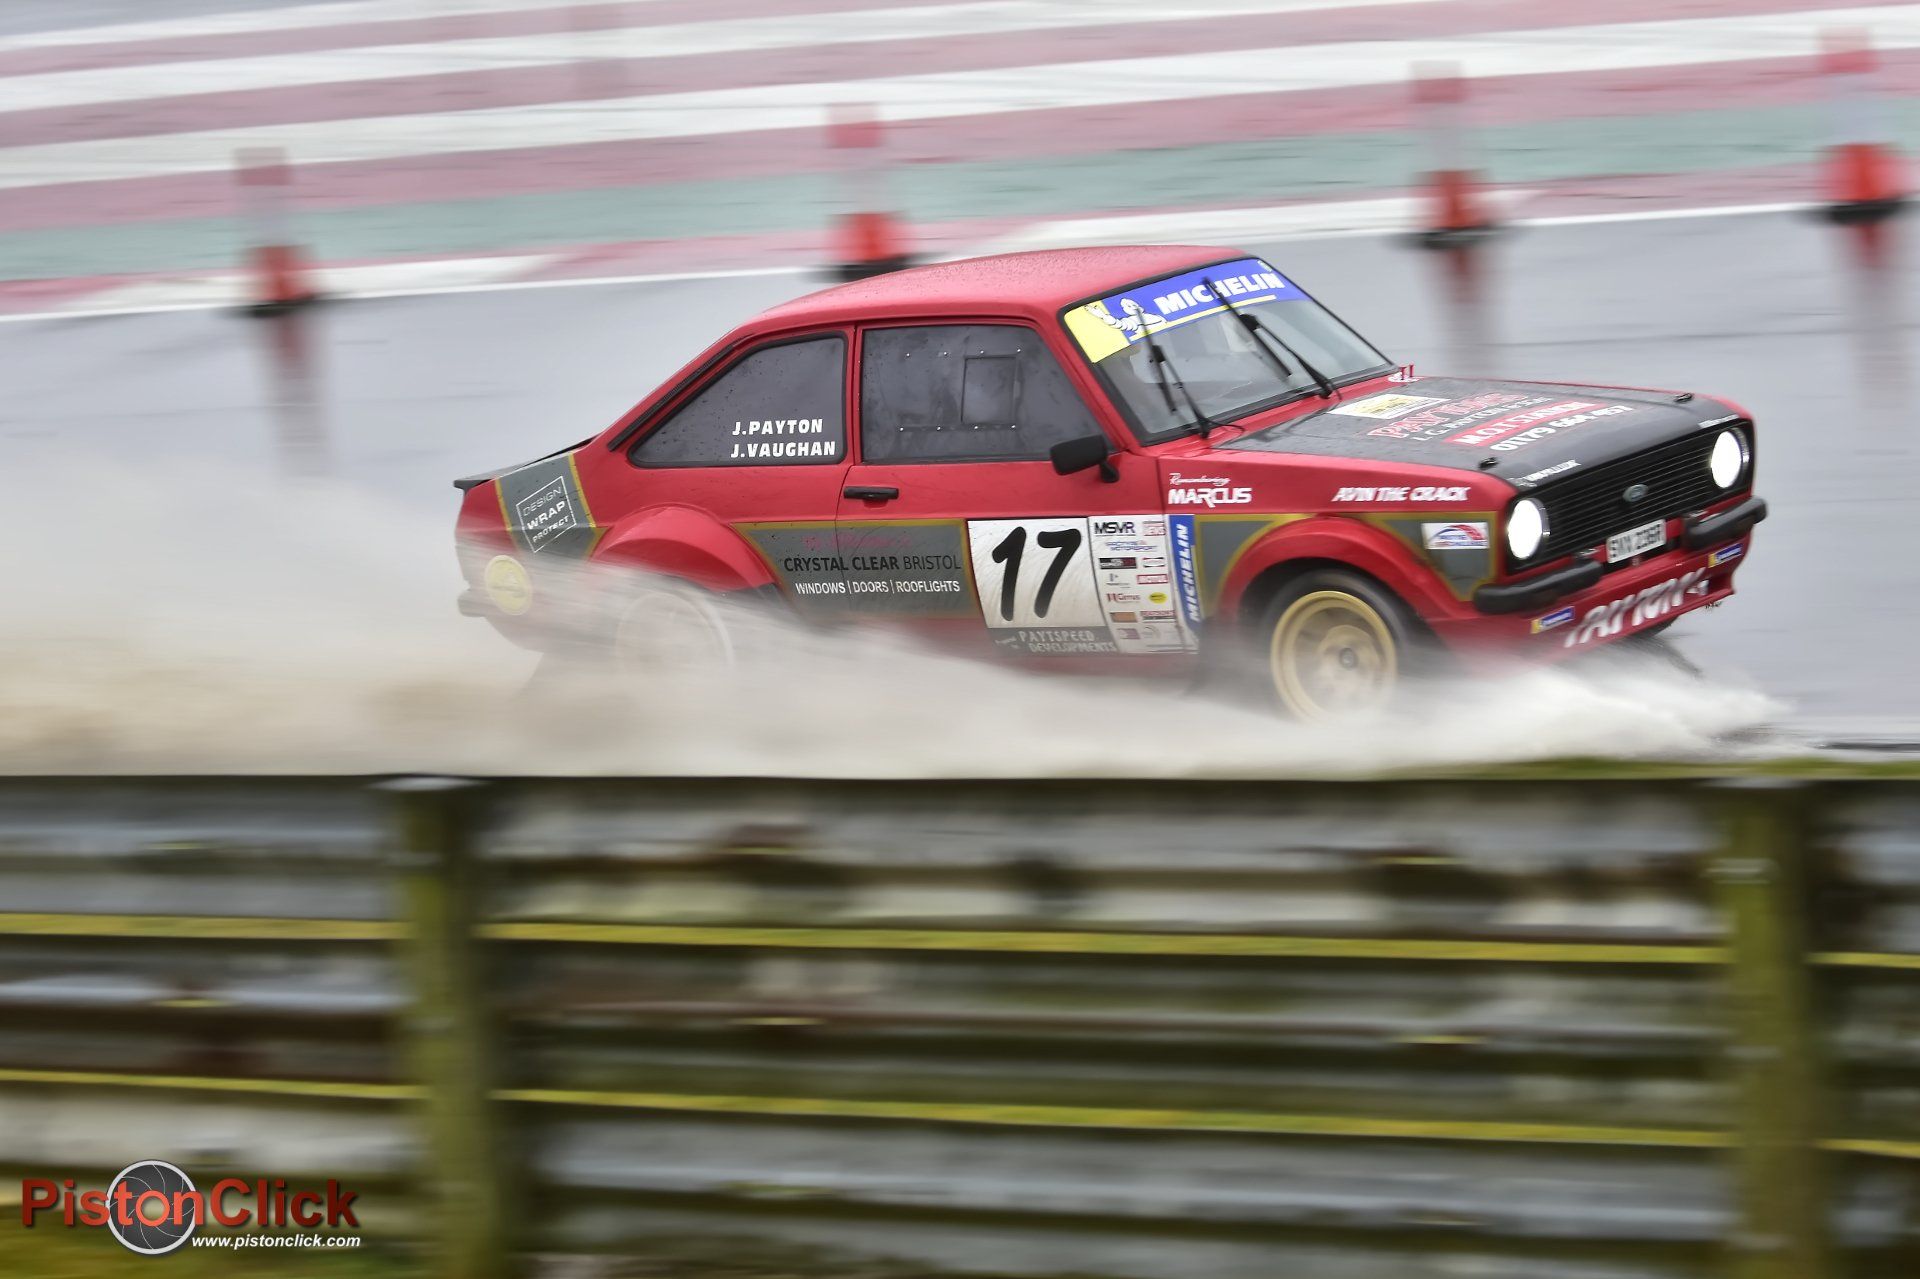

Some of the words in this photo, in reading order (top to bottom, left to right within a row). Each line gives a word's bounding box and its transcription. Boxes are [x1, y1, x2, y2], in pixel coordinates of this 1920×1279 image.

[1153, 273, 1285, 315] MICHELIN
[732, 418, 823, 436] J.PAYTON
[731, 441, 836, 458] J.VAUGHAN
[523, 487, 561, 516] DESIGN
[1168, 487, 1253, 508] MARCUS
[1375, 486, 1410, 502] THE
[527, 501, 565, 530] WRAP
[532, 515, 569, 543] PROTECT
[1094, 522, 1136, 535] MSVR
[784, 557, 849, 572] CRYSTAL
[852, 556, 899, 571] CLEAR
[903, 555, 961, 570] BRISTOL
[1176, 523, 1200, 623] MICHELIN
[991, 526, 1081, 621] 17
[795, 582, 846, 595] WINDOWS
[853, 581, 888, 593] DOORS
[896, 580, 960, 593] ROOFLIGHTS
[1018, 630, 1095, 642] PAYTSPEED
